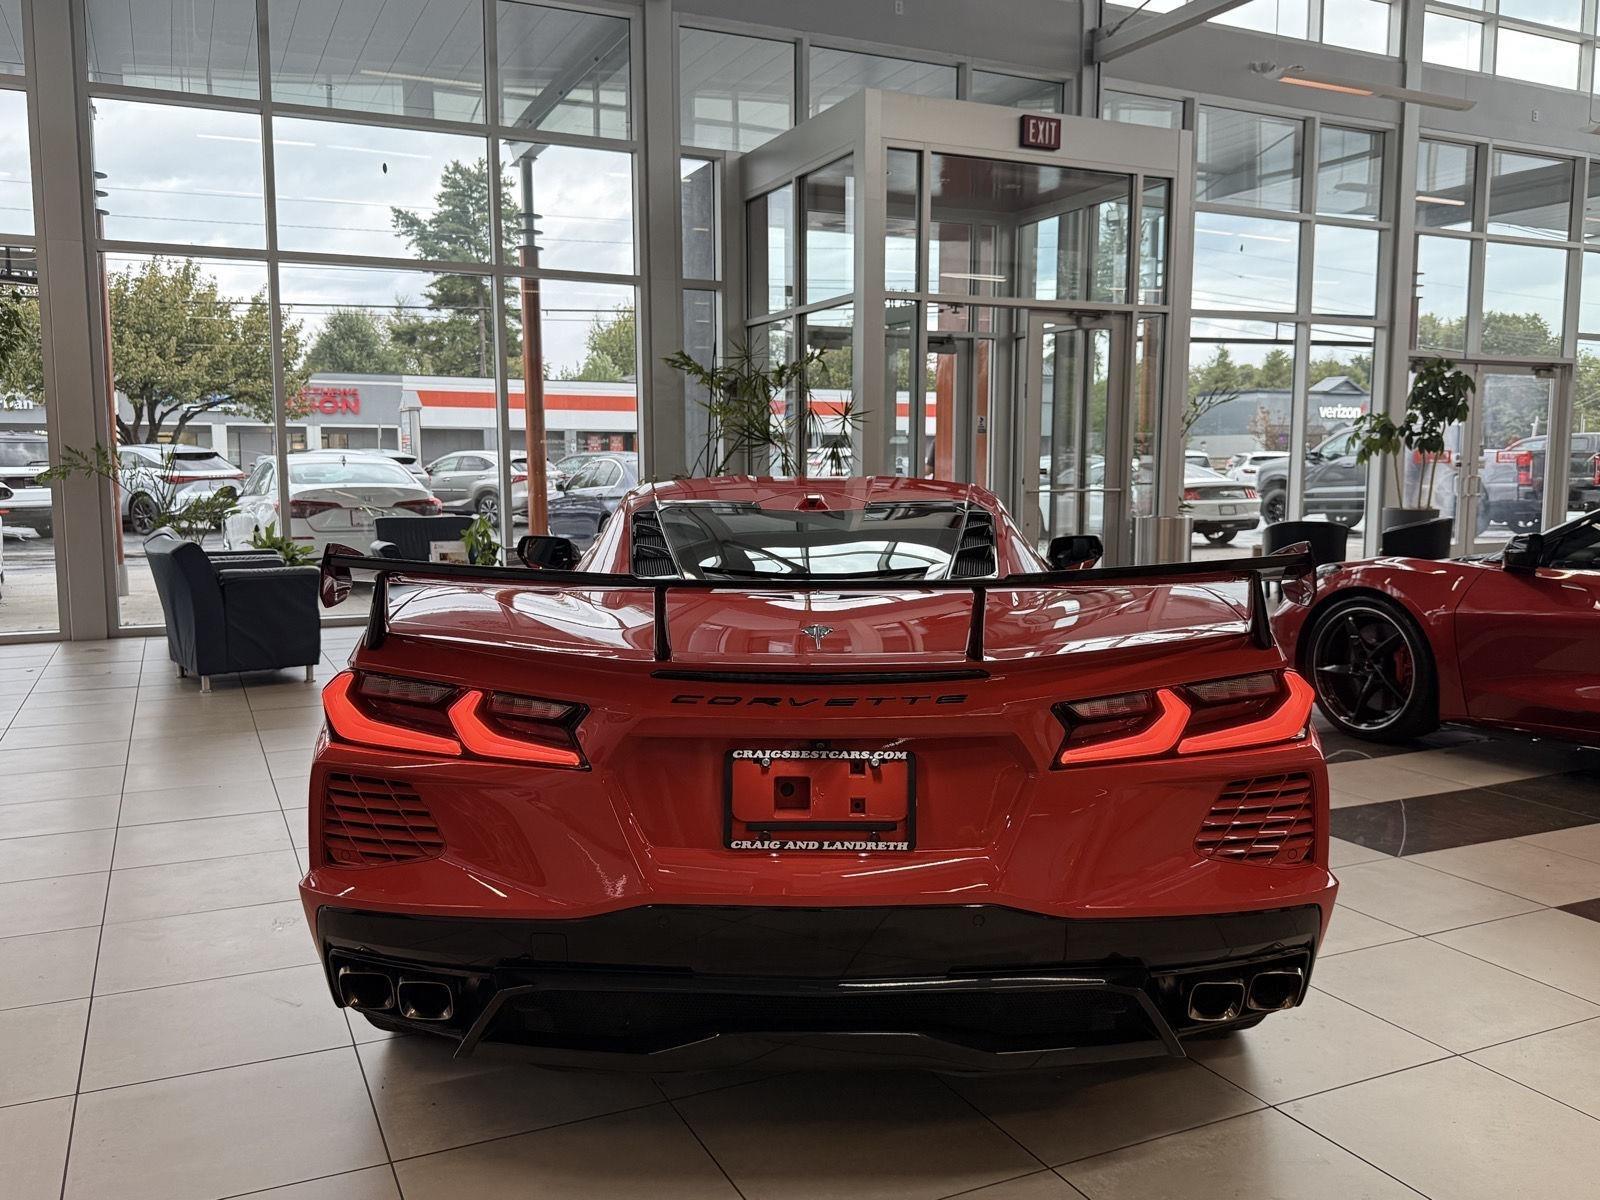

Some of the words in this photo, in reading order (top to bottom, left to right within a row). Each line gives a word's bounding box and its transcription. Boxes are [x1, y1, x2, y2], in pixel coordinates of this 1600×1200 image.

[1029, 119, 1057, 145] EXIT
[1319, 403, 1361, 419] verizon
[671, 694, 968, 707] CORVETTE
[732, 749, 908, 760] CRAIGSBESTCARS.COM
[730, 840, 781, 849] CRAIG
[784, 840, 819, 850] AND
[822, 840, 909, 851] LANDRETH
